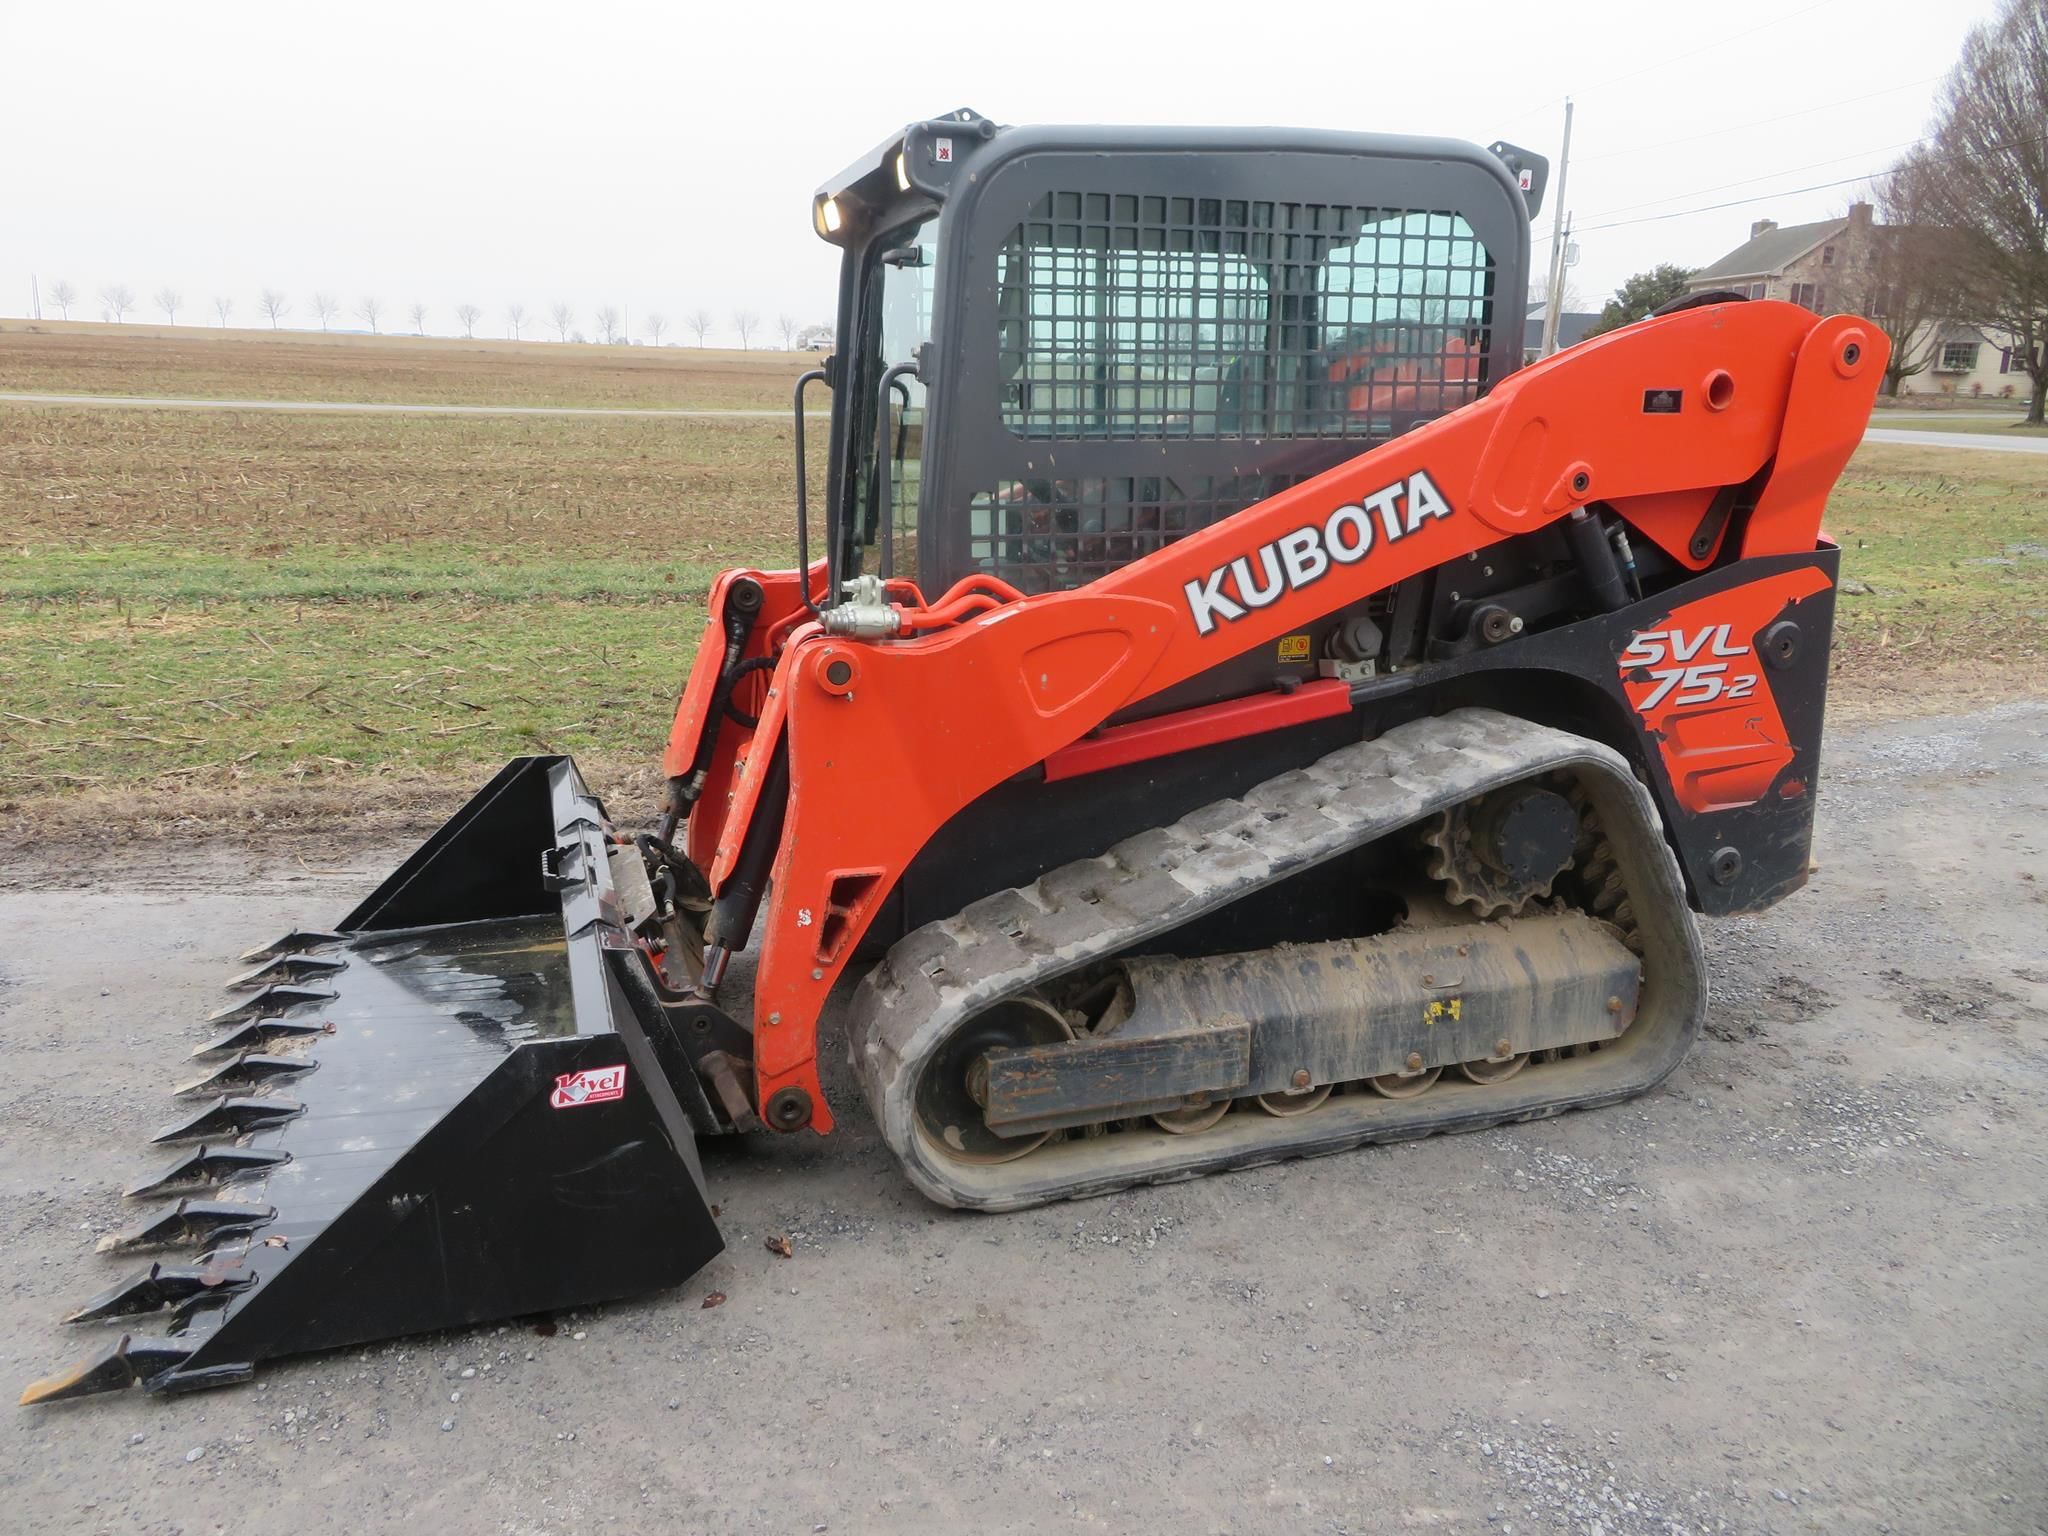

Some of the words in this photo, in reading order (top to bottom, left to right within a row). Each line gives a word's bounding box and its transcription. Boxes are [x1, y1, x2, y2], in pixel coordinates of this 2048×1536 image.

[1184, 469, 1453, 636] KUBOTA
[1619, 624, 1749, 668] SVL
[1637, 662, 1758, 712] 75-2
[558, 1071, 620, 1104] Kivel
